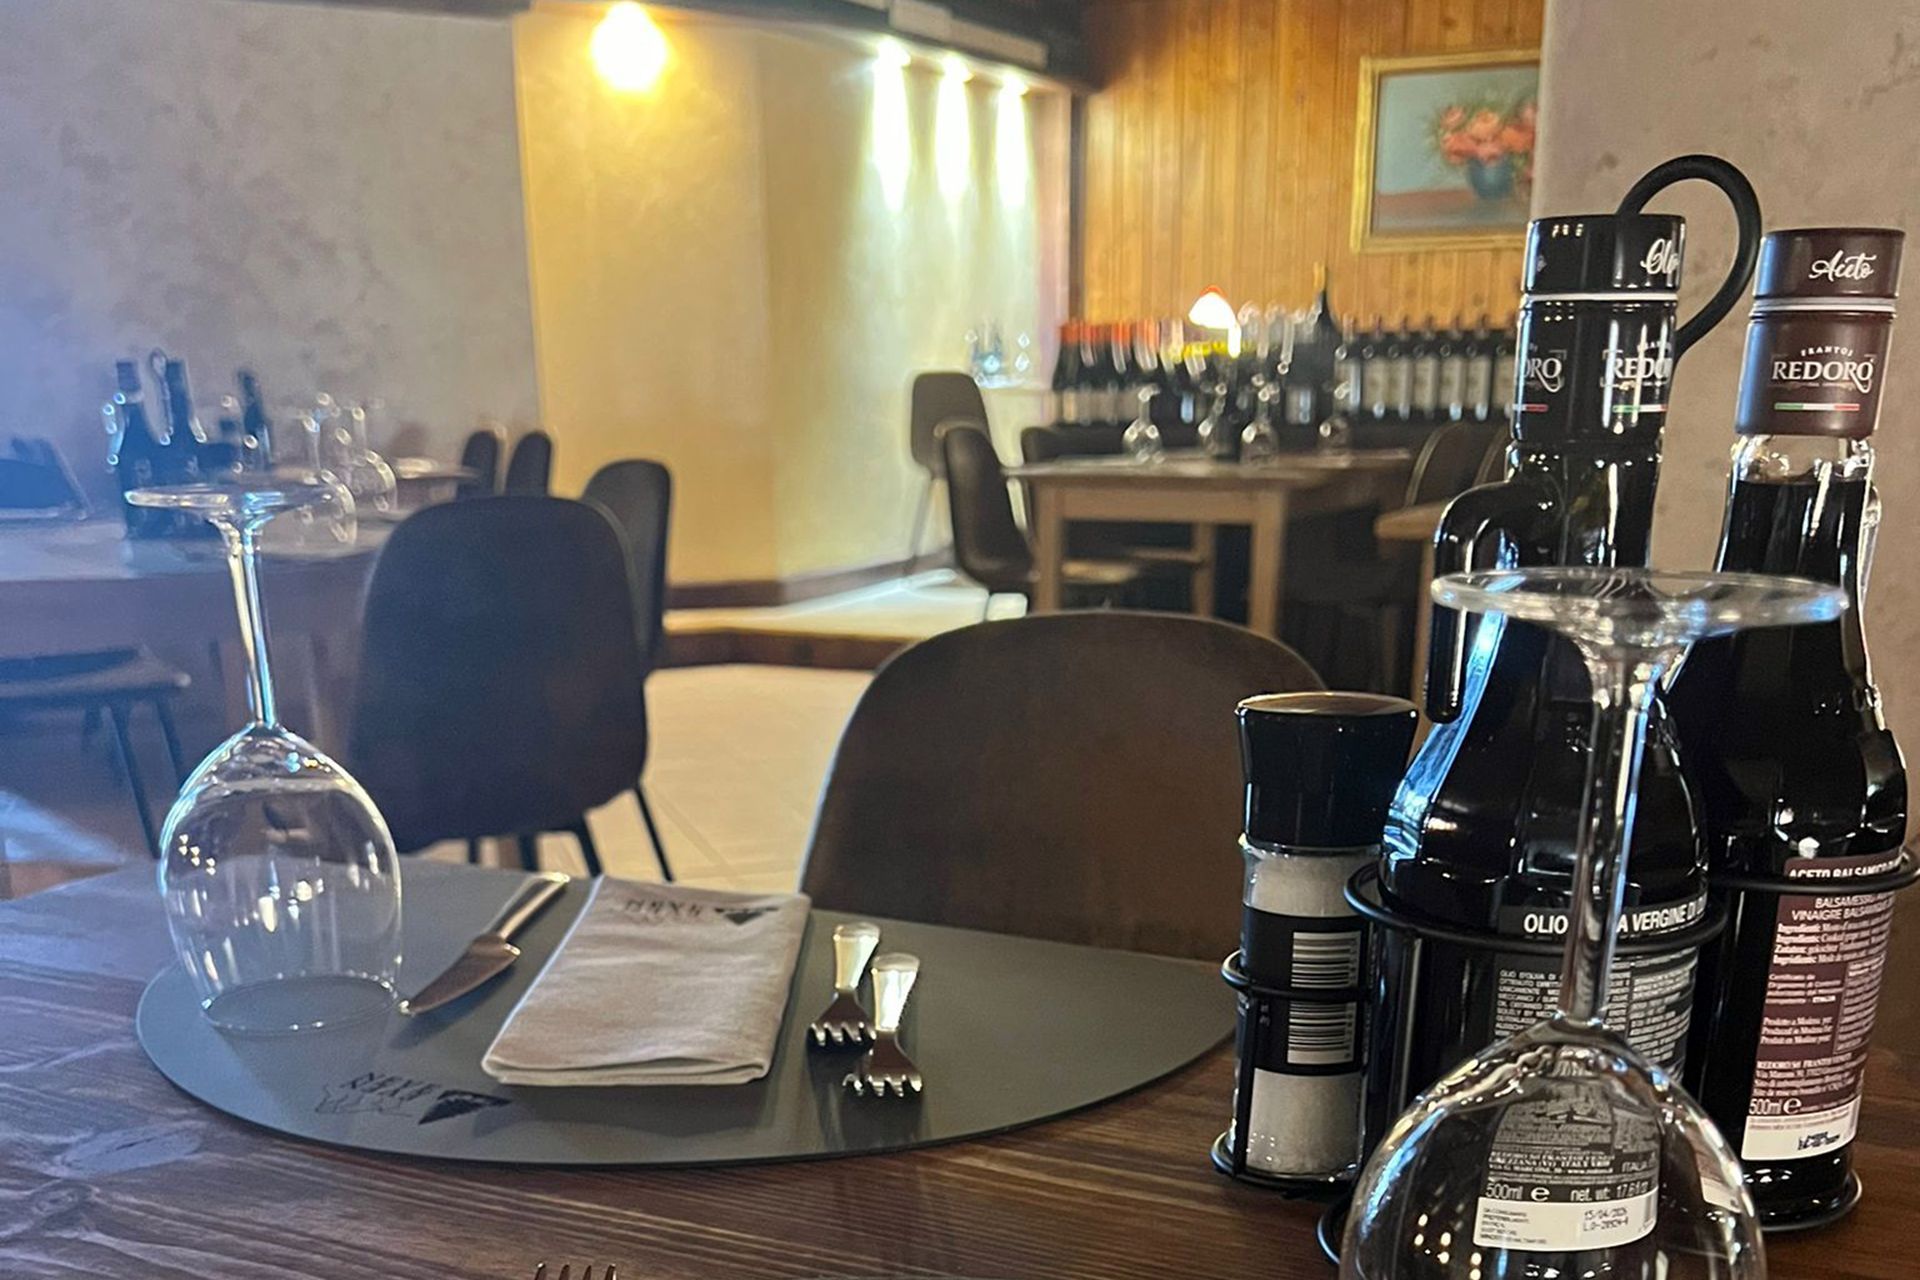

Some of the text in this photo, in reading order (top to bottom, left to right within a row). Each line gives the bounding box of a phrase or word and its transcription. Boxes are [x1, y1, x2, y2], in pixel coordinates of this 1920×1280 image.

[1808, 250, 1877, 282] Aceto
[1523, 914, 1569, 935] OLIO
[1632, 904, 1687, 932] VERGINE
[1749, 1099, 1781, 1115] 500ml
[1485, 1183, 1523, 1200] 500ml
